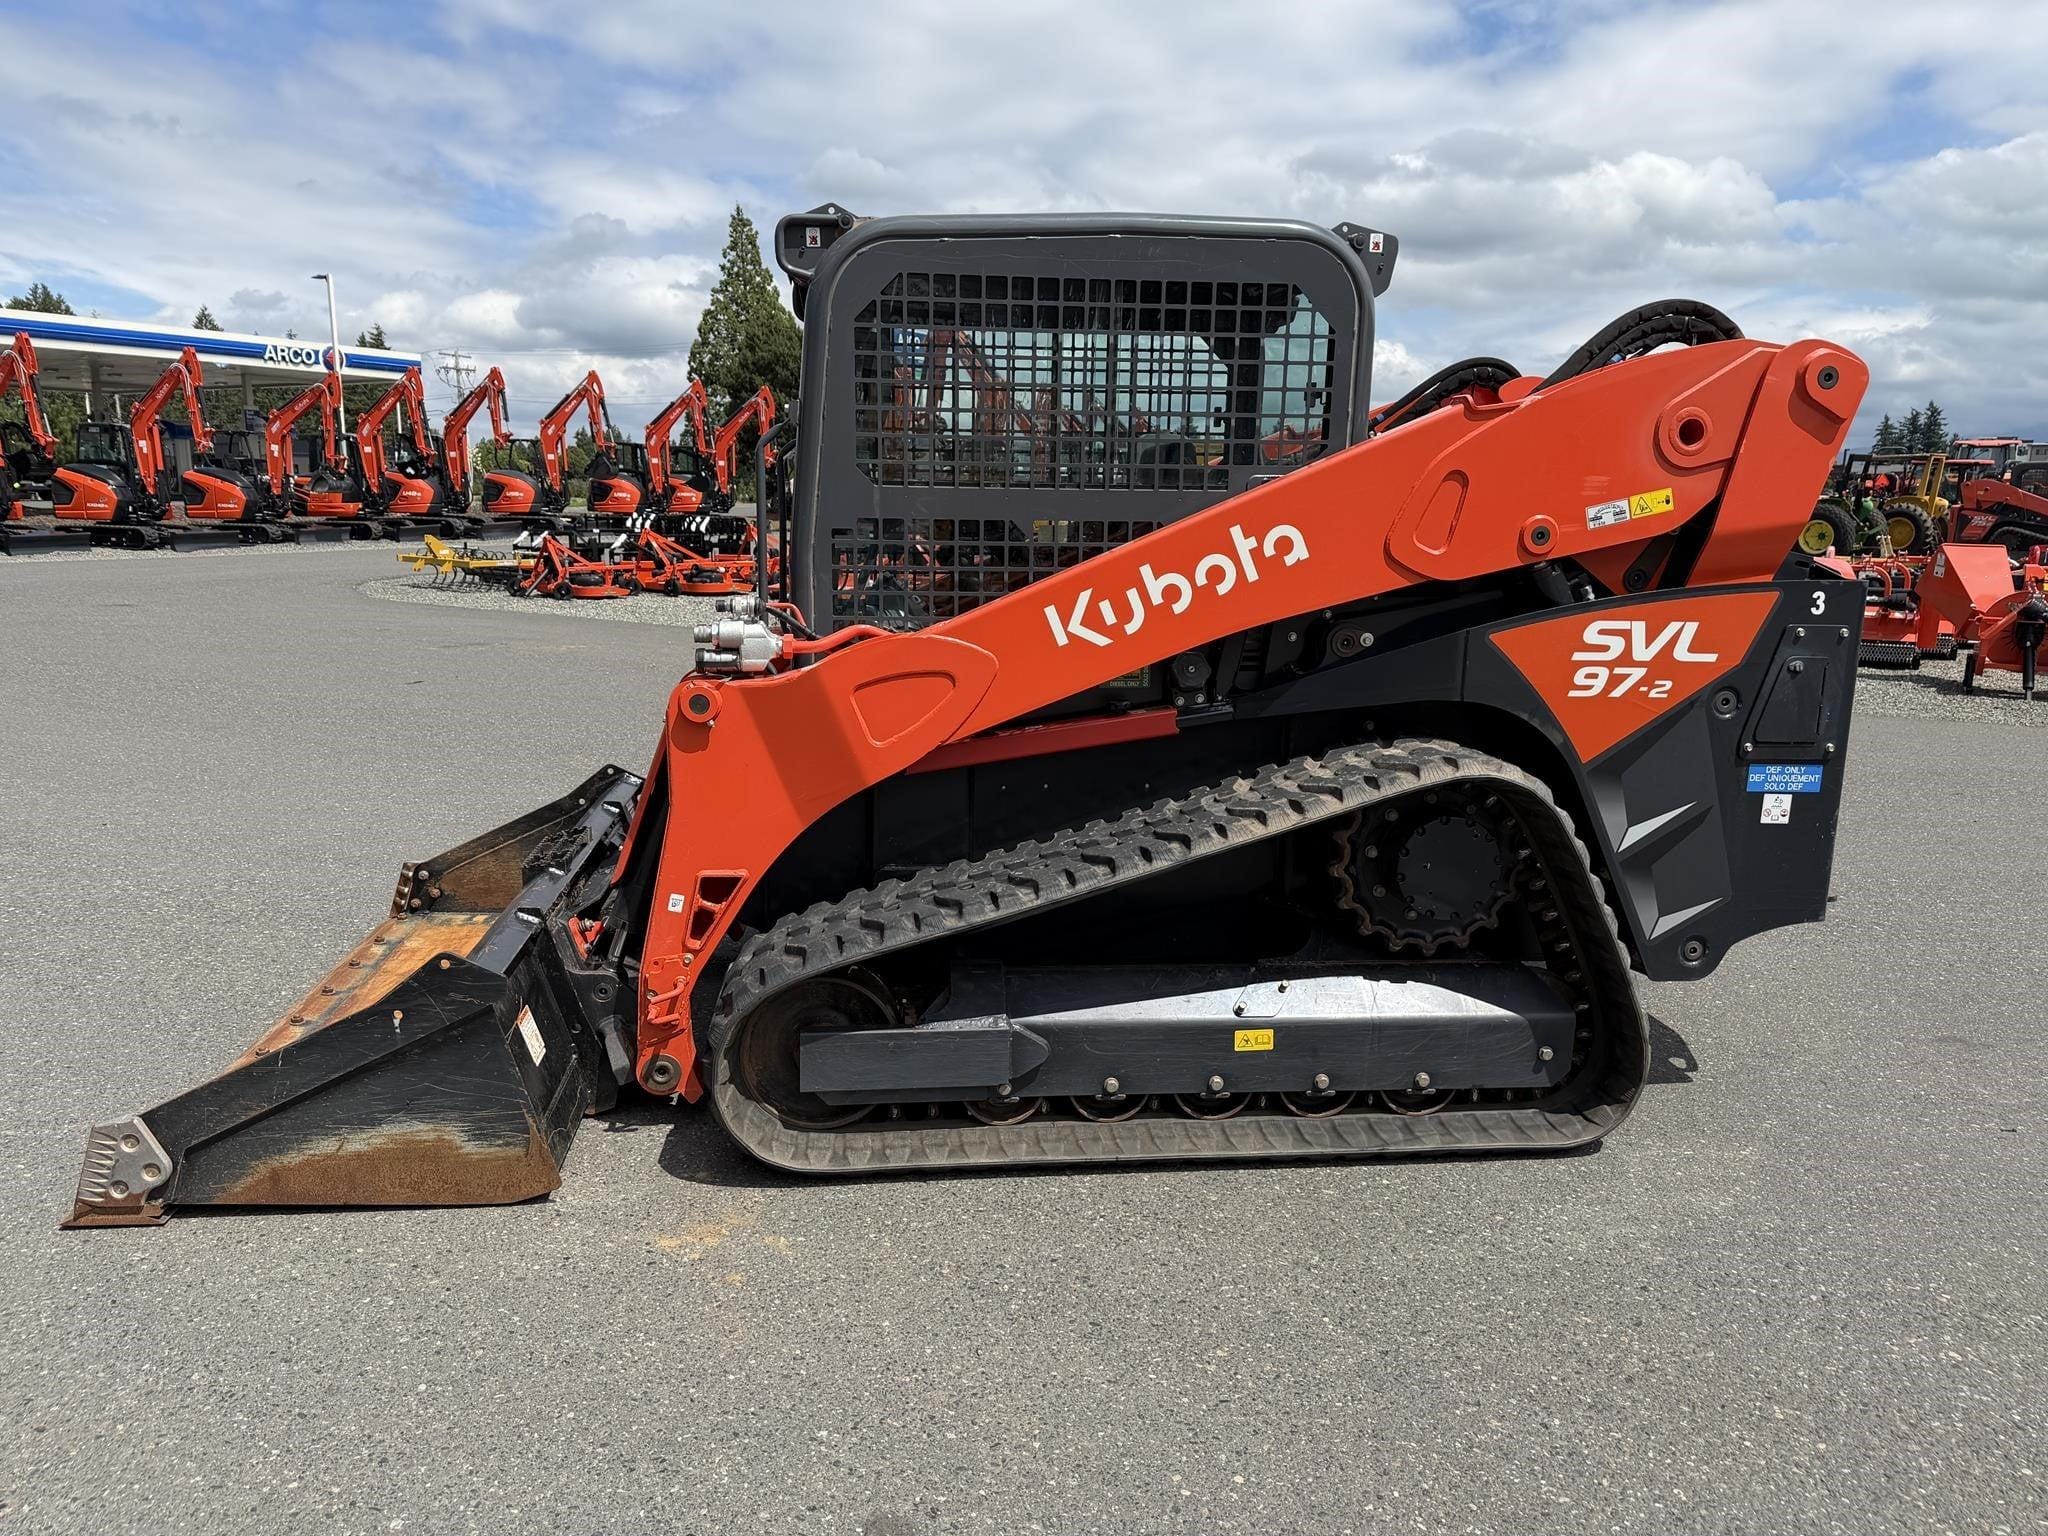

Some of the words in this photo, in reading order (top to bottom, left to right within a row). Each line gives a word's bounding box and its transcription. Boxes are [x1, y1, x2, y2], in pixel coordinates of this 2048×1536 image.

[264, 345, 315, 363] ARCO
[1044, 524, 1310, 647] Kubota
[1810, 590, 1826, 615] 3
[1571, 620, 1719, 662] SVL
[1567, 666, 1673, 698] 97-2
